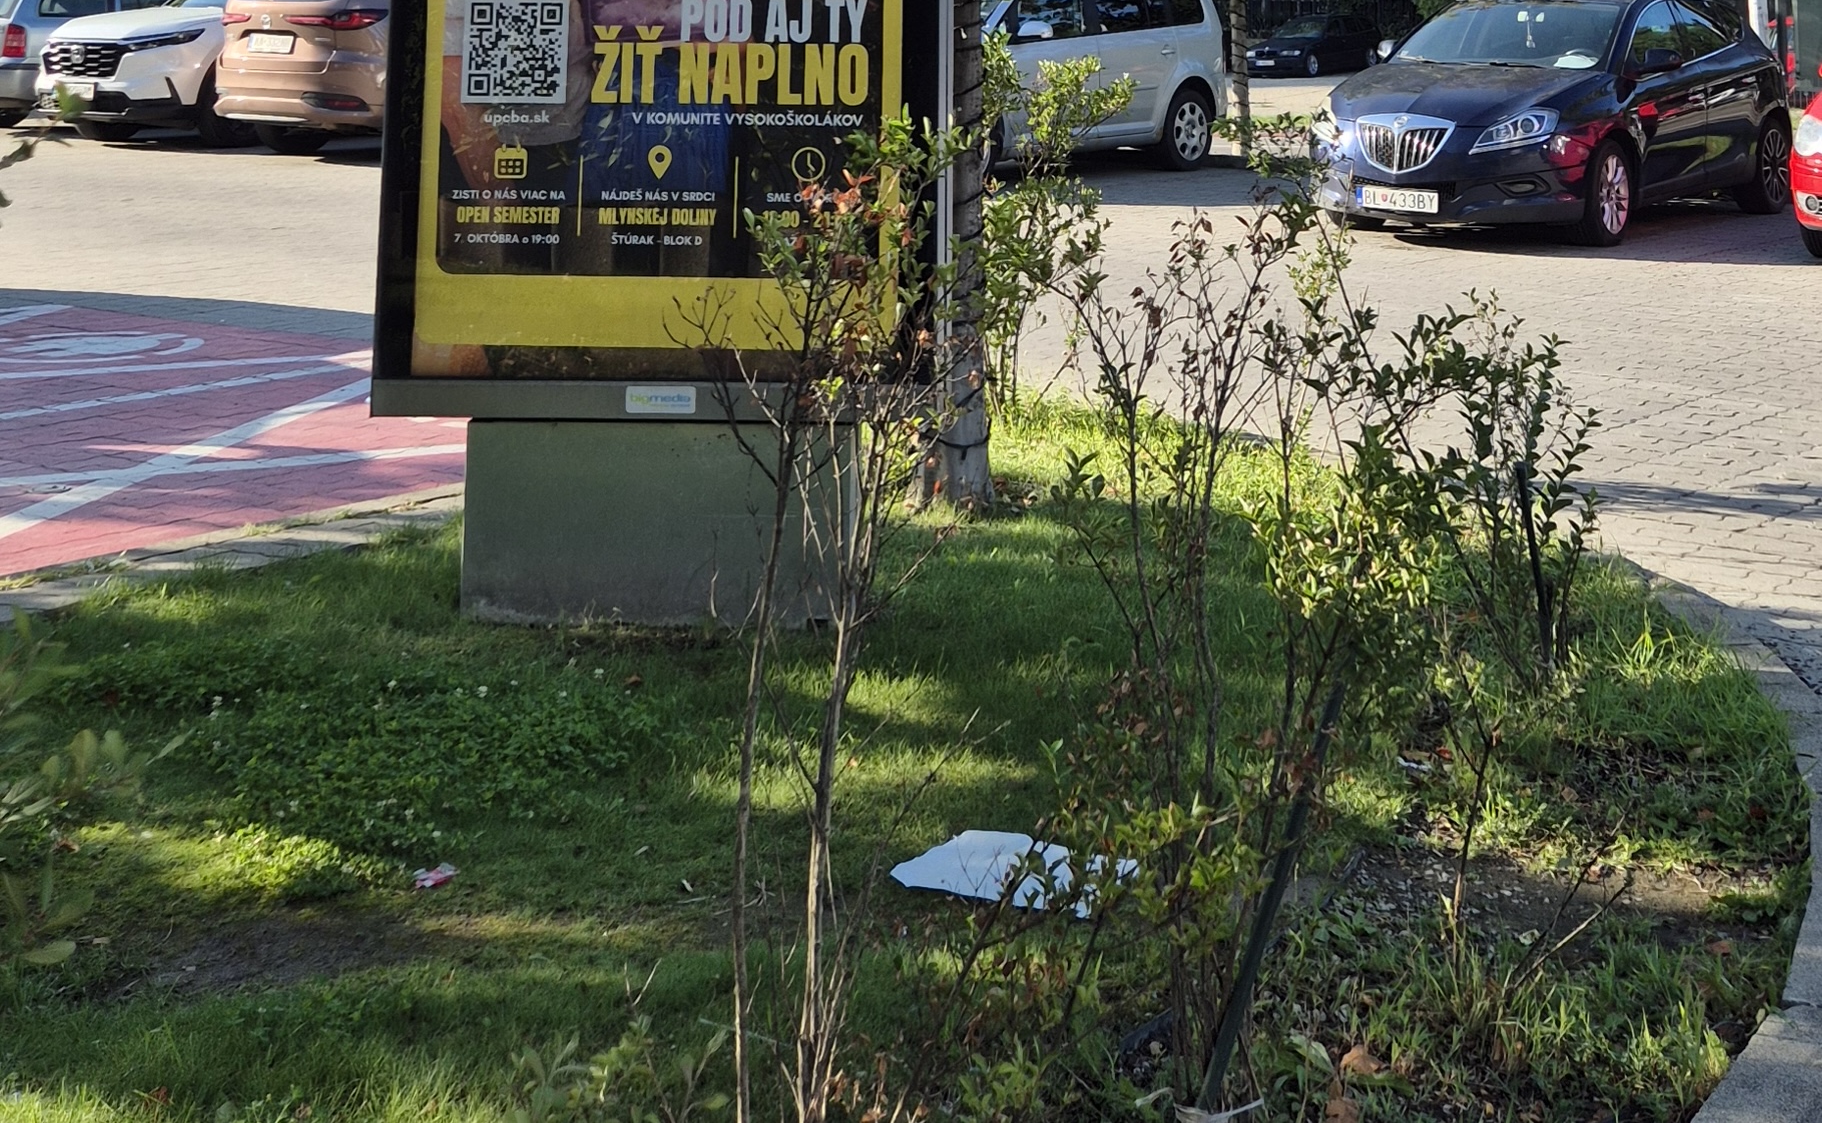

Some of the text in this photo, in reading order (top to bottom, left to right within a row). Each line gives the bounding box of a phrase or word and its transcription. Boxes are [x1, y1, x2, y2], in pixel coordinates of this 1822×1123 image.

[590, 25, 869, 106] ŽIŤ NAPLNO
[484, 109, 550, 127] upcba.sk
[632, 110, 863, 126] V KOMUNITE VYSOKOŠKOLÁKOV
[452, 187, 566, 200] ZISTI O NÁS VIAC NA
[601, 188, 715, 201] NÁJDEŠ NÁS V SRDCI
[766, 193, 791, 203] SME
[1364, 189, 1435, 210] BL 433BY
[456, 206, 560, 224] OPEN SEMESTER
[598, 207, 717, 226] MLYNSKEJ DOLINY
[467, 231, 519, 244] OKTÓBRA
[531, 234, 560, 244] 19:00
[611, 232, 654, 245] ŠTÚRAK
[663, 235, 692, 246] BLOK
[694, 236, 703, 246] D
[630, 393, 691, 406] bigmedia
